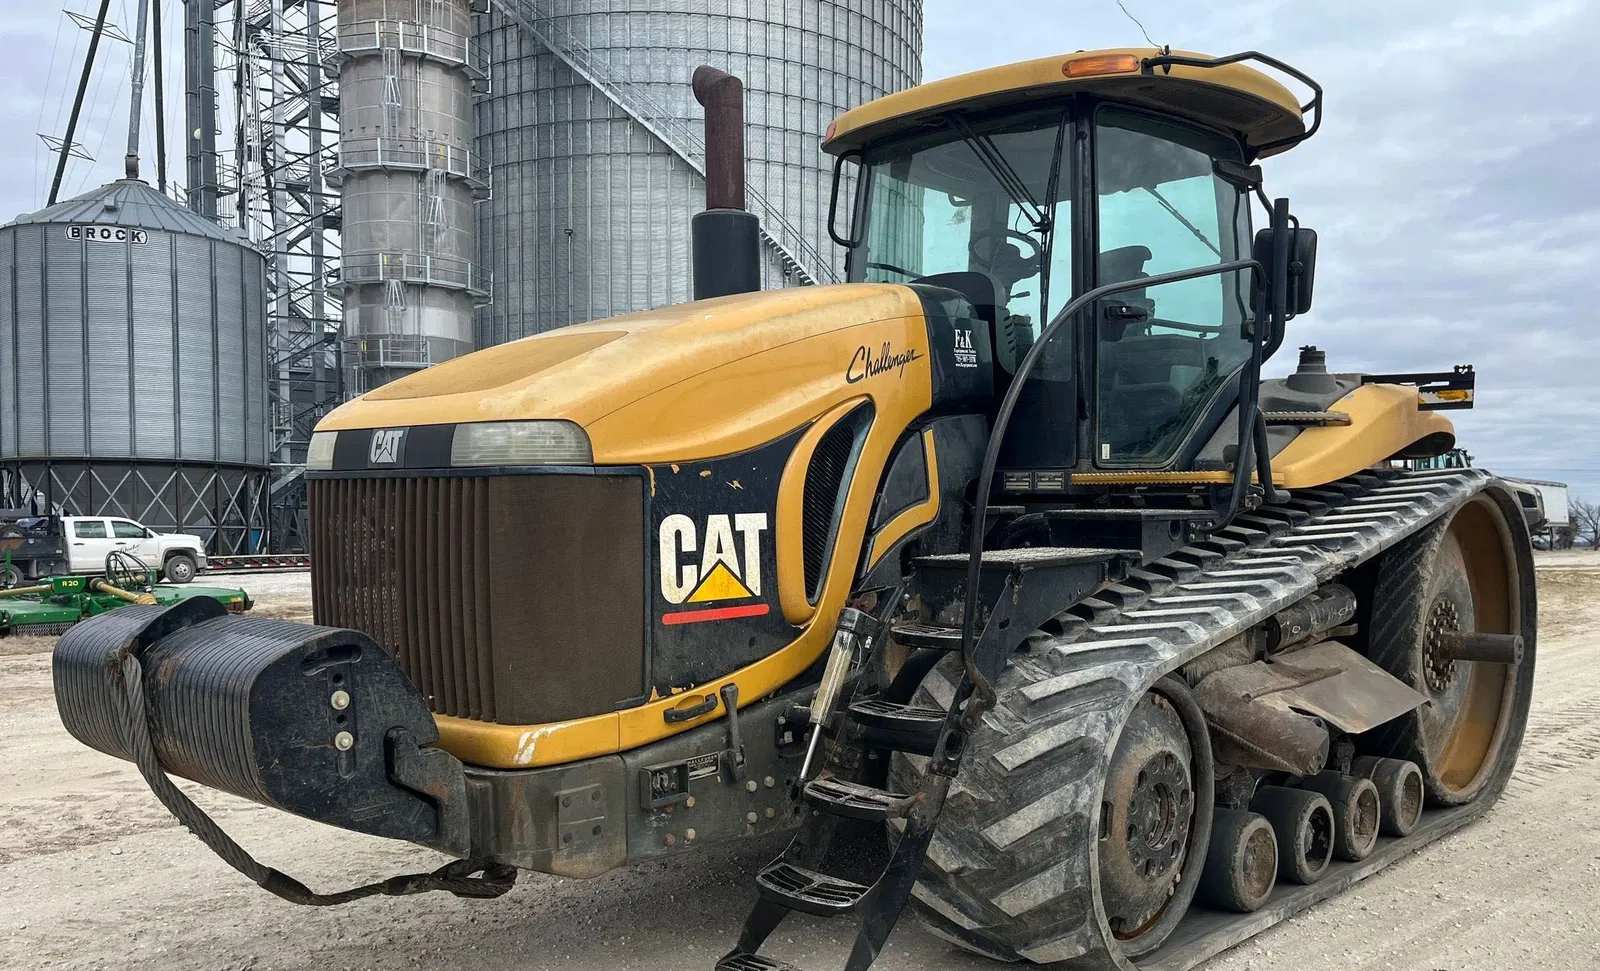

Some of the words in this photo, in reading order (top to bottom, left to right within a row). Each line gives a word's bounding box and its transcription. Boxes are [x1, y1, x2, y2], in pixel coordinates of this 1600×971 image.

[71, 226, 141, 242] BROCK
[954, 329, 972, 348] F&K
[845, 341, 924, 384] Challenger
[370, 430, 403, 464] CAT
[659, 513, 768, 604] CAT
